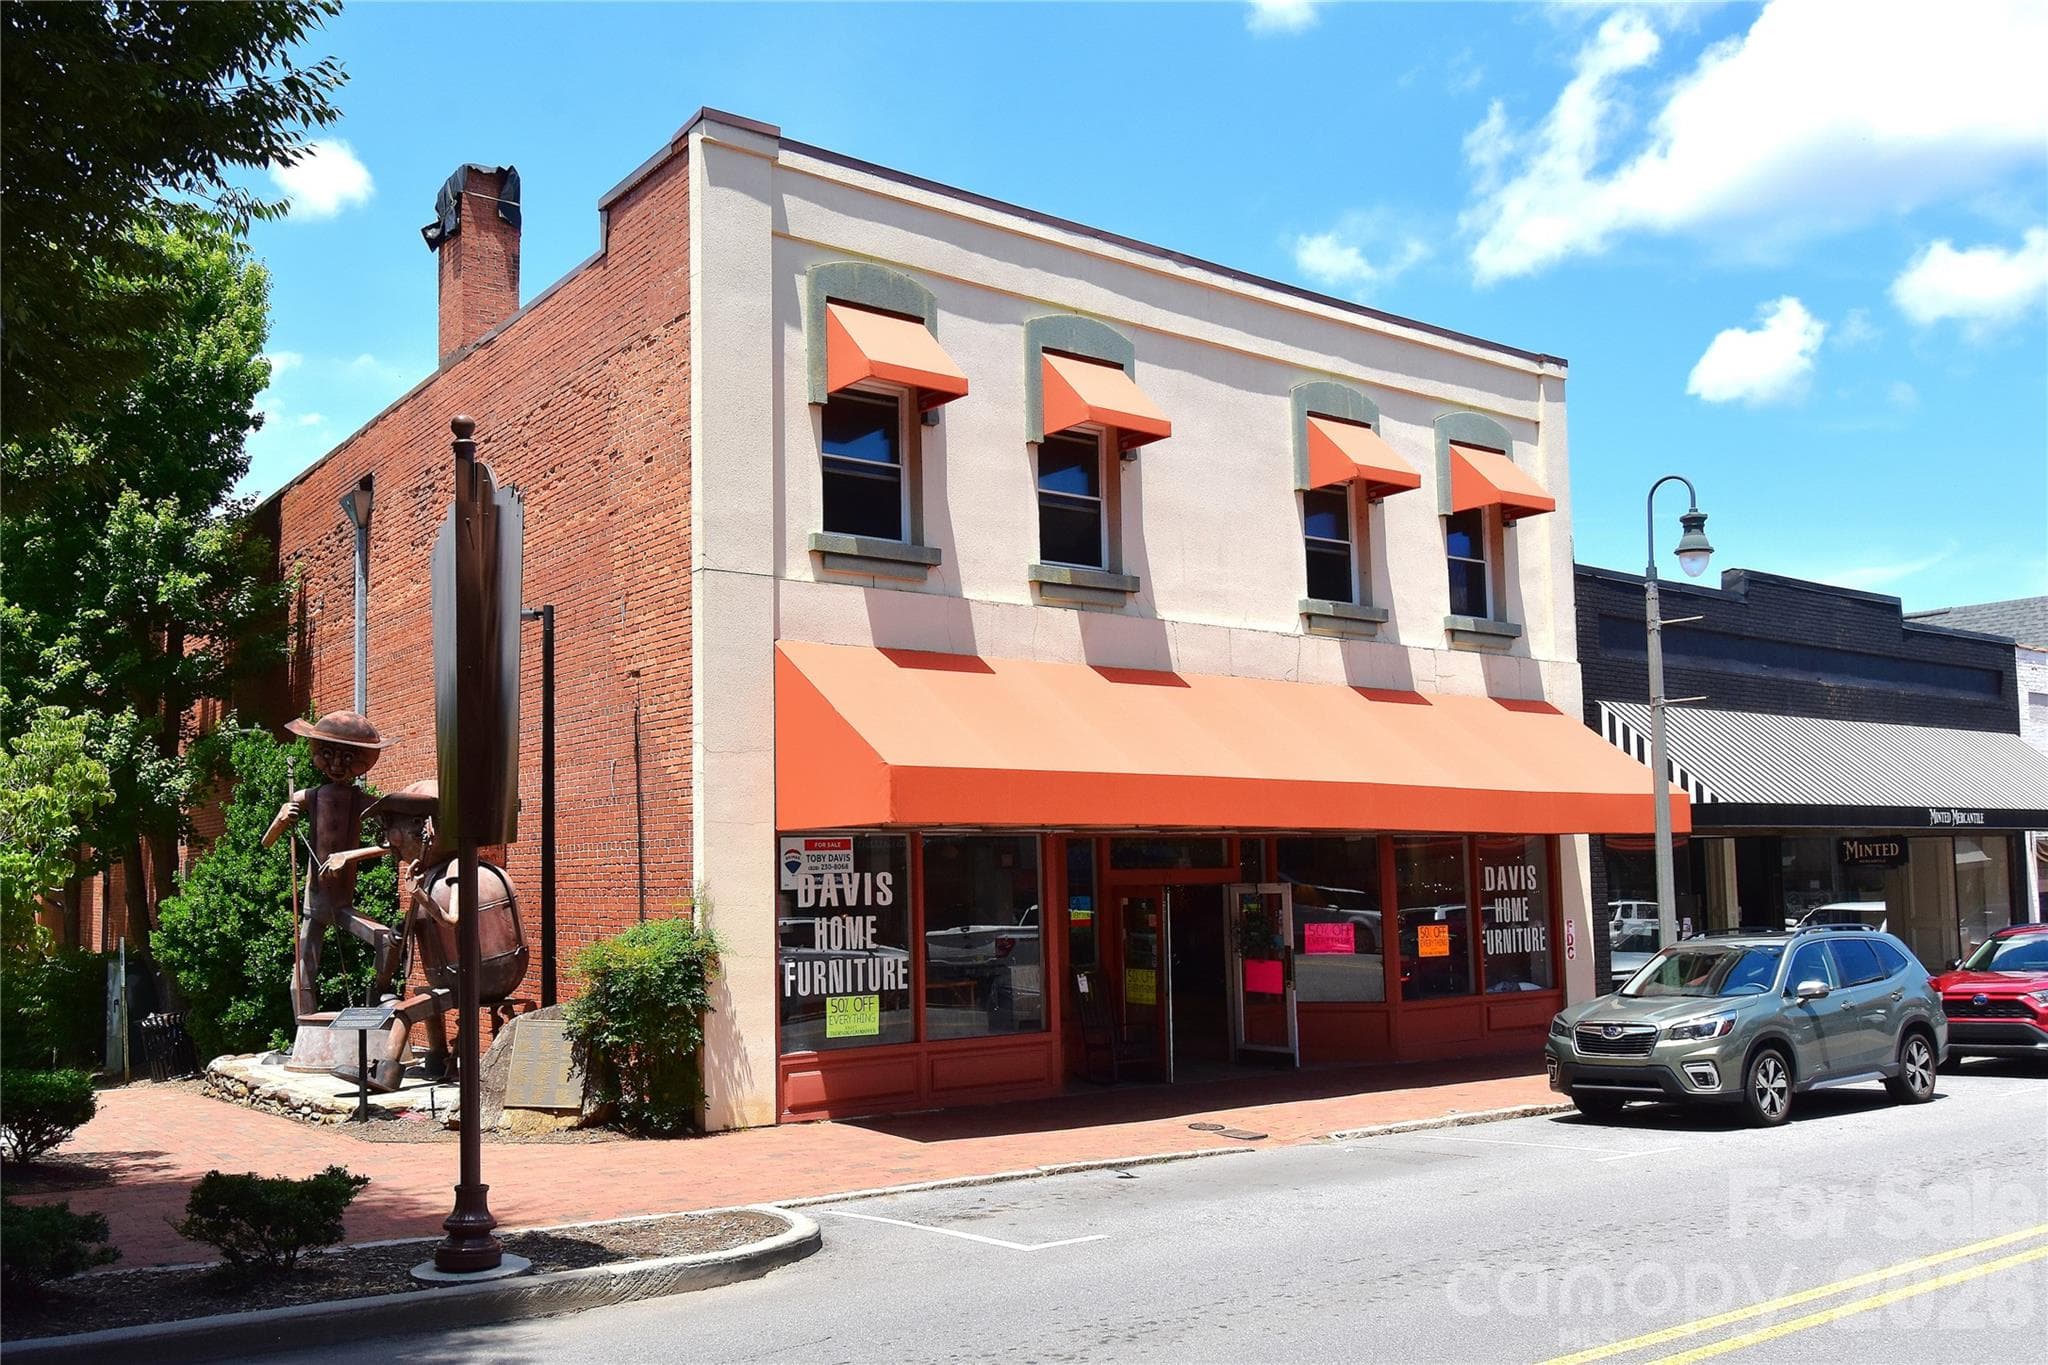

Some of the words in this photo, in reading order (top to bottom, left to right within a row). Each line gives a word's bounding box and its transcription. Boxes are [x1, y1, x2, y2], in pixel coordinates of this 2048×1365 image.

[1928, 808, 1951, 826] MINTED
[1951, 809, 1984, 826] MERCANTILE
[806, 853, 827, 863] TOBY
[828, 853, 851, 862] DAVIS
[1843, 840, 1899, 862] MINTED
[797, 871, 893, 908] DAVIS
[1484, 865, 1537, 891] DAVIS
[1494, 897, 1529, 923] HOME
[814, 915, 878, 951] HOME
[784, 957, 909, 997] FURNITURE
[853, 996, 875, 1012] OFF
[829, 1012, 876, 1026] EVERYTHING
